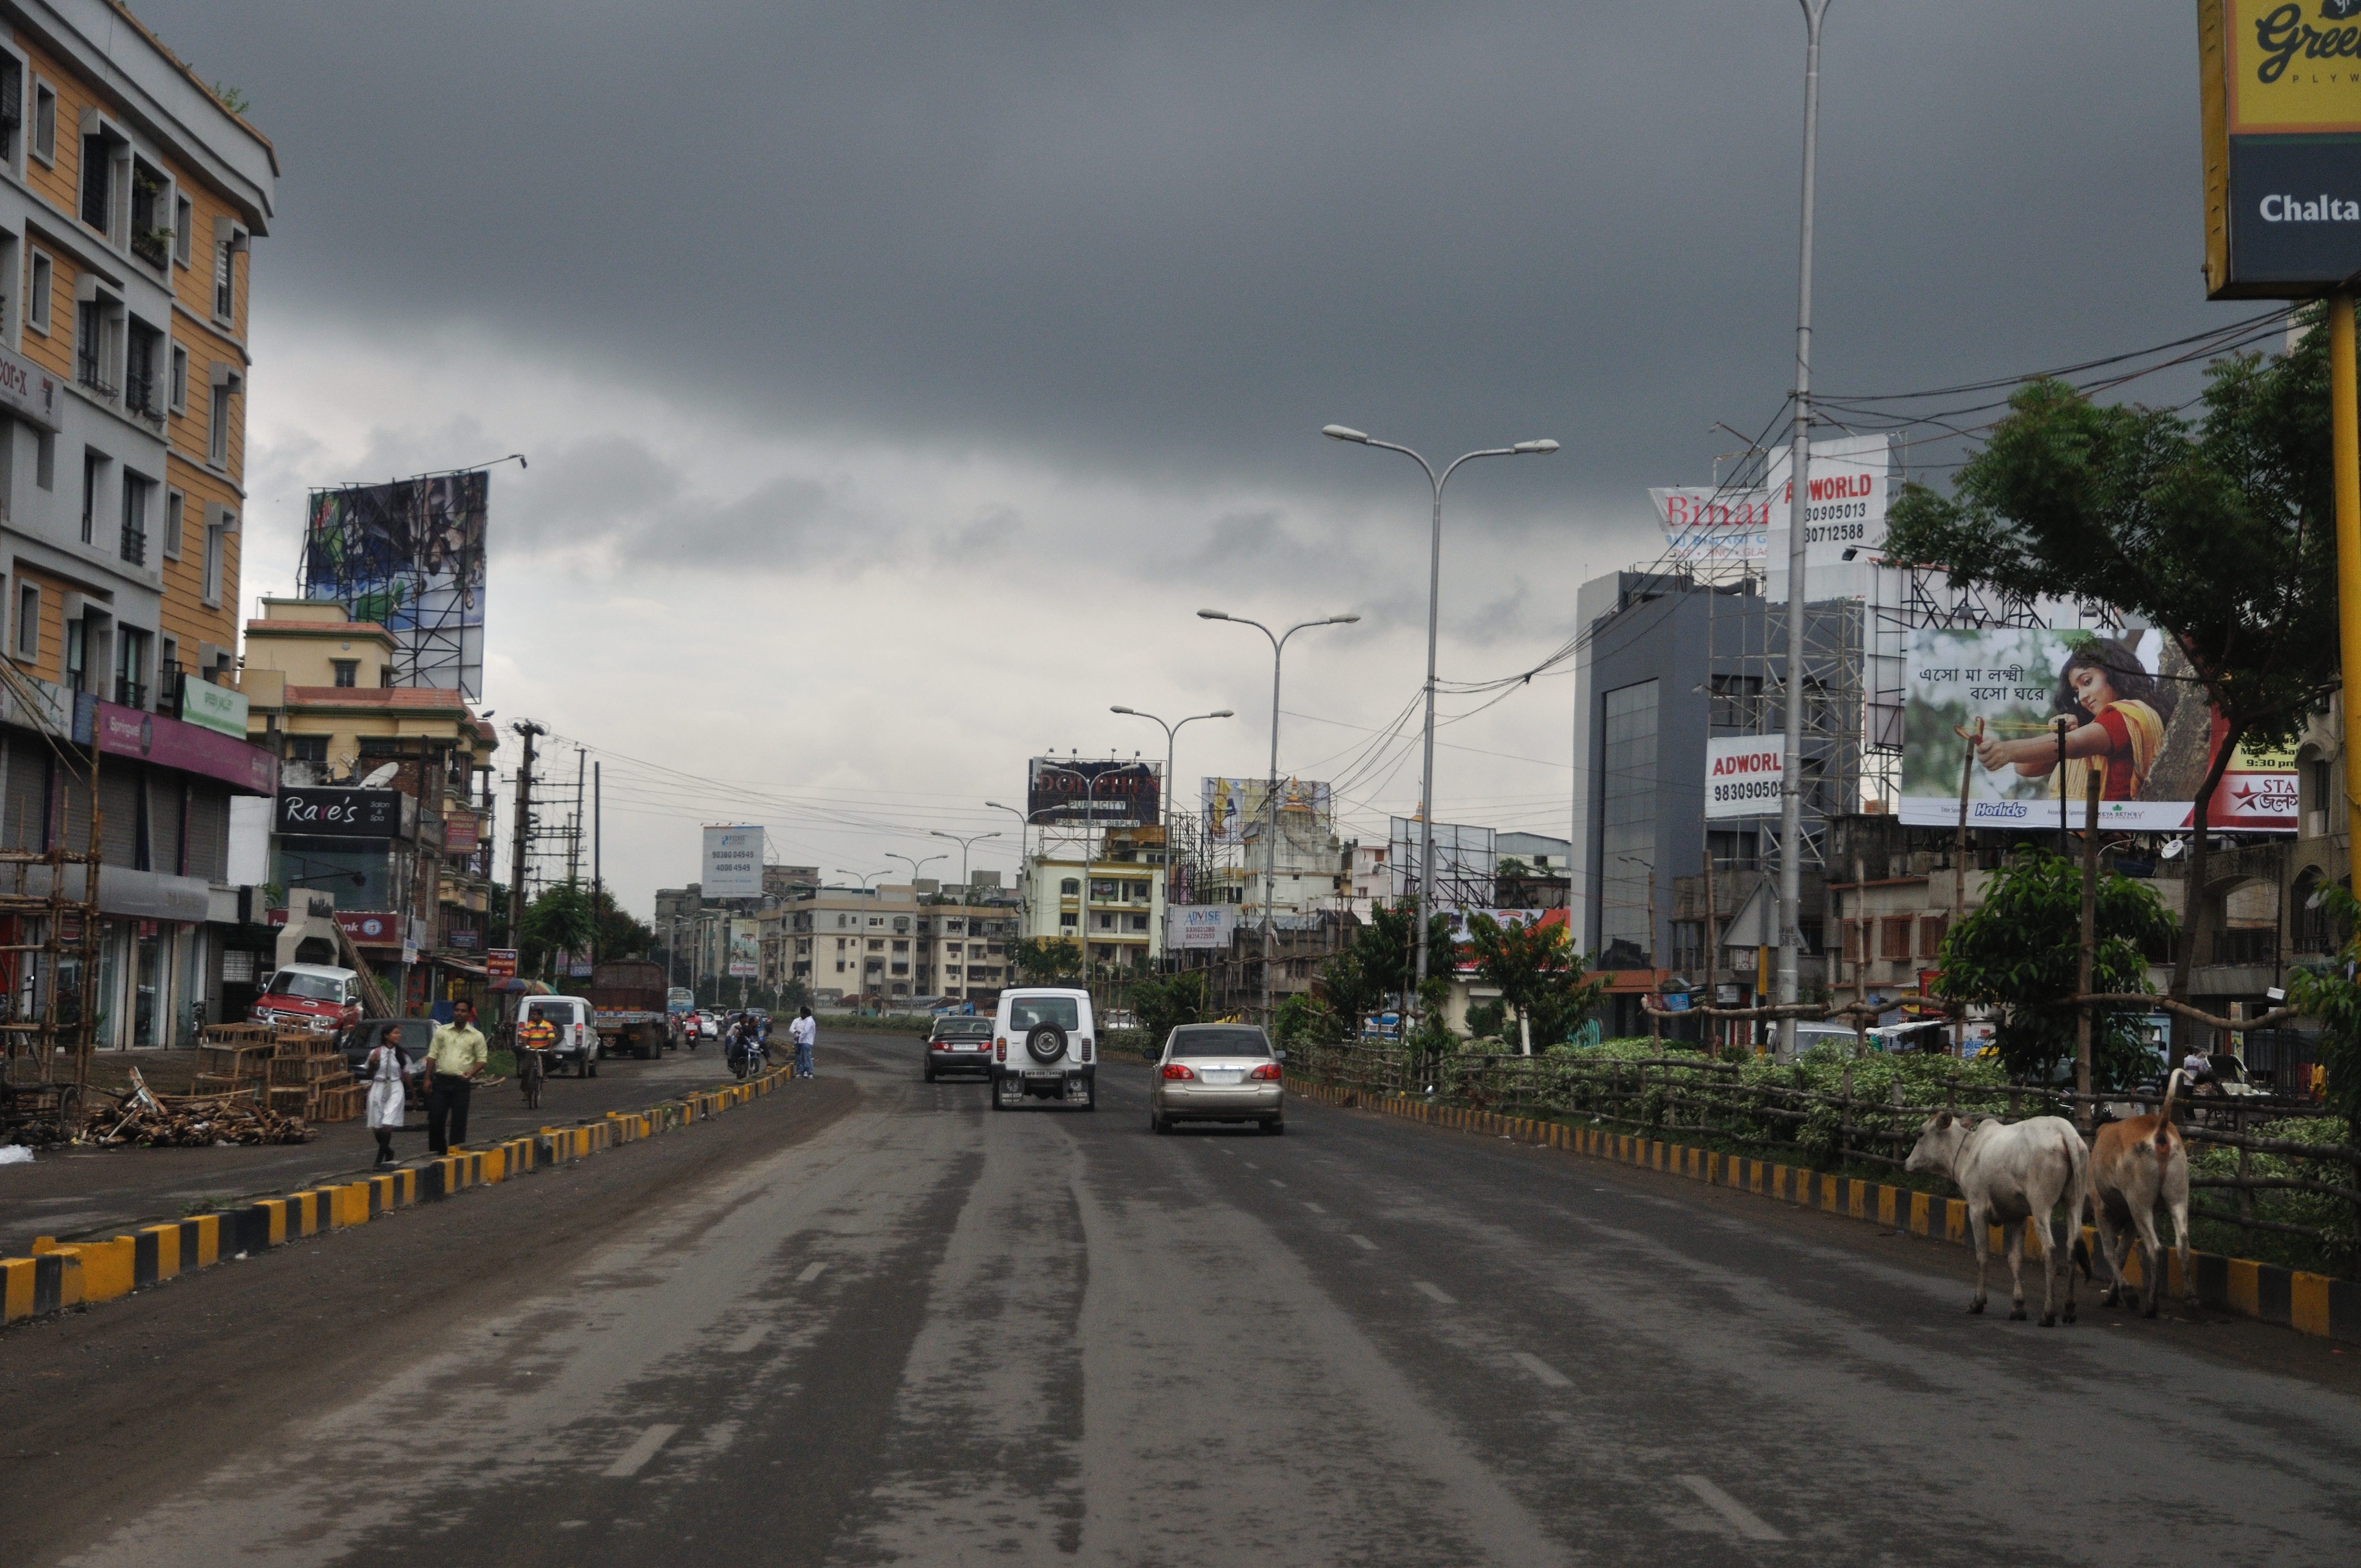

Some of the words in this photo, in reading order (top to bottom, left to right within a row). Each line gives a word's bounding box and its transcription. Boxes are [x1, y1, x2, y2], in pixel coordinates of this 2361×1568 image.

[2260, 194, 2360, 222] Chalta
[1784, 473, 1872, 504] AWORLD
[1920, 668, 1960, 682] এসো
[1965, 668, 1982, 682] মা
[1970, 687, 2009, 700] বসো
[2014, 688, 2046, 701] ঘরে
[1039, 774, 1160, 794] DOLPHIN
[2264, 779, 2298, 793] STA
[286, 796, 358, 823] Rare's
[1069, 801, 1125, 810] PUBLICITY
[1974, 802, 2027, 818] Horlicks
[1184, 907, 1221, 925] ADVISE
